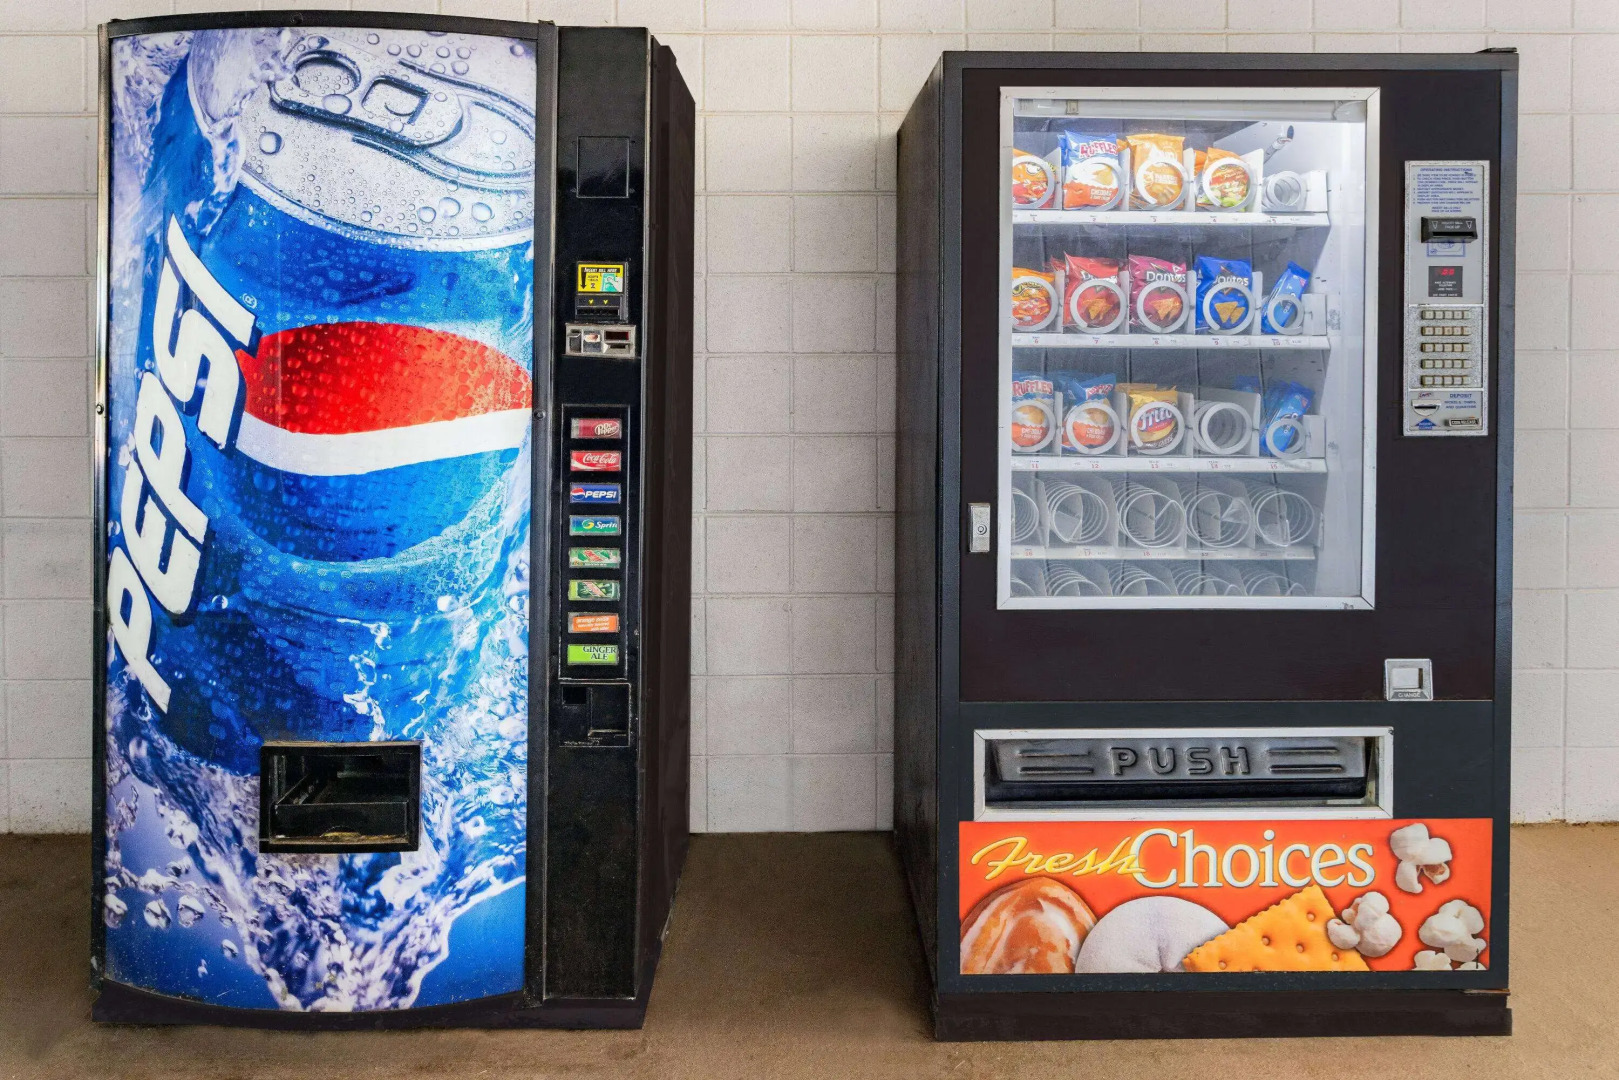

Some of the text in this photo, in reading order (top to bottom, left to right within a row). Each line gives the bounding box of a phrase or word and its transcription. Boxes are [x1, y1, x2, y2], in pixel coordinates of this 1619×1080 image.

[1146, 271, 1186, 283] Doritos
[1012, 380, 1053, 397] RUFFLES
[107, 212, 257, 714] PEPSI
[582, 453, 619, 464] Coca-Cola
[584, 491, 617, 499] PEPSI
[582, 646, 617, 654] GINGER
[1109, 745, 1251, 776] PUSH
[971, 827, 1376, 888] Fresh Choices
